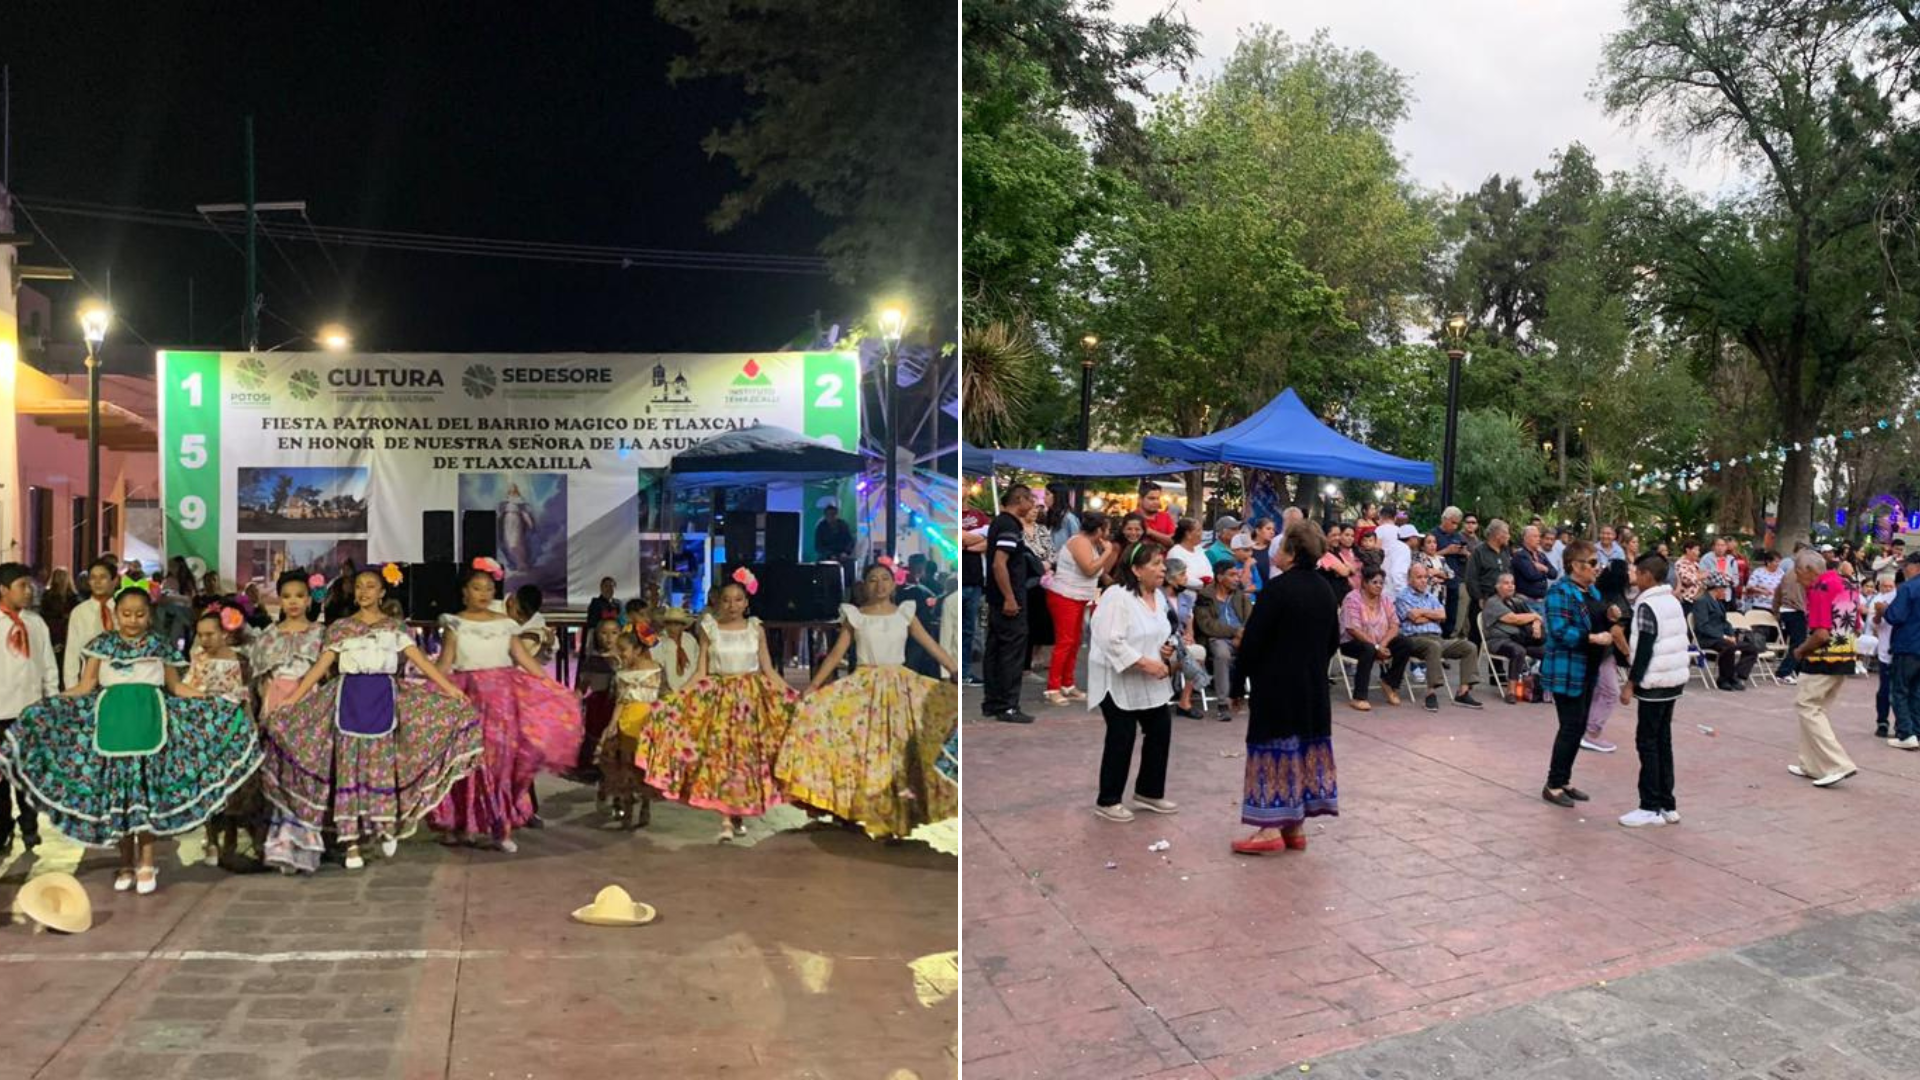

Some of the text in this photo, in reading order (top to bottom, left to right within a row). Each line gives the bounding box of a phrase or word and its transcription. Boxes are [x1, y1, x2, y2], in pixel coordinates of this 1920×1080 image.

[328, 368, 444, 387] CULTURA
[502, 367, 612, 383] SEDESORE
[262, 417, 761, 430] FIESTA PATRONAL DEL BARRIO MAGICO DE TLAXCALA
[278, 437, 303, 450] EN
[308, 437, 375, 450] HONOR
[384, 437, 410, 450] DE
[414, 437, 502, 450] NUESTRA
[507, 433, 585, 450] SEÑORA
[590, 437, 615, 450] DE
[618, 437, 643, 450] LA
[434, 457, 592, 469] DE TLAXCALILLA
